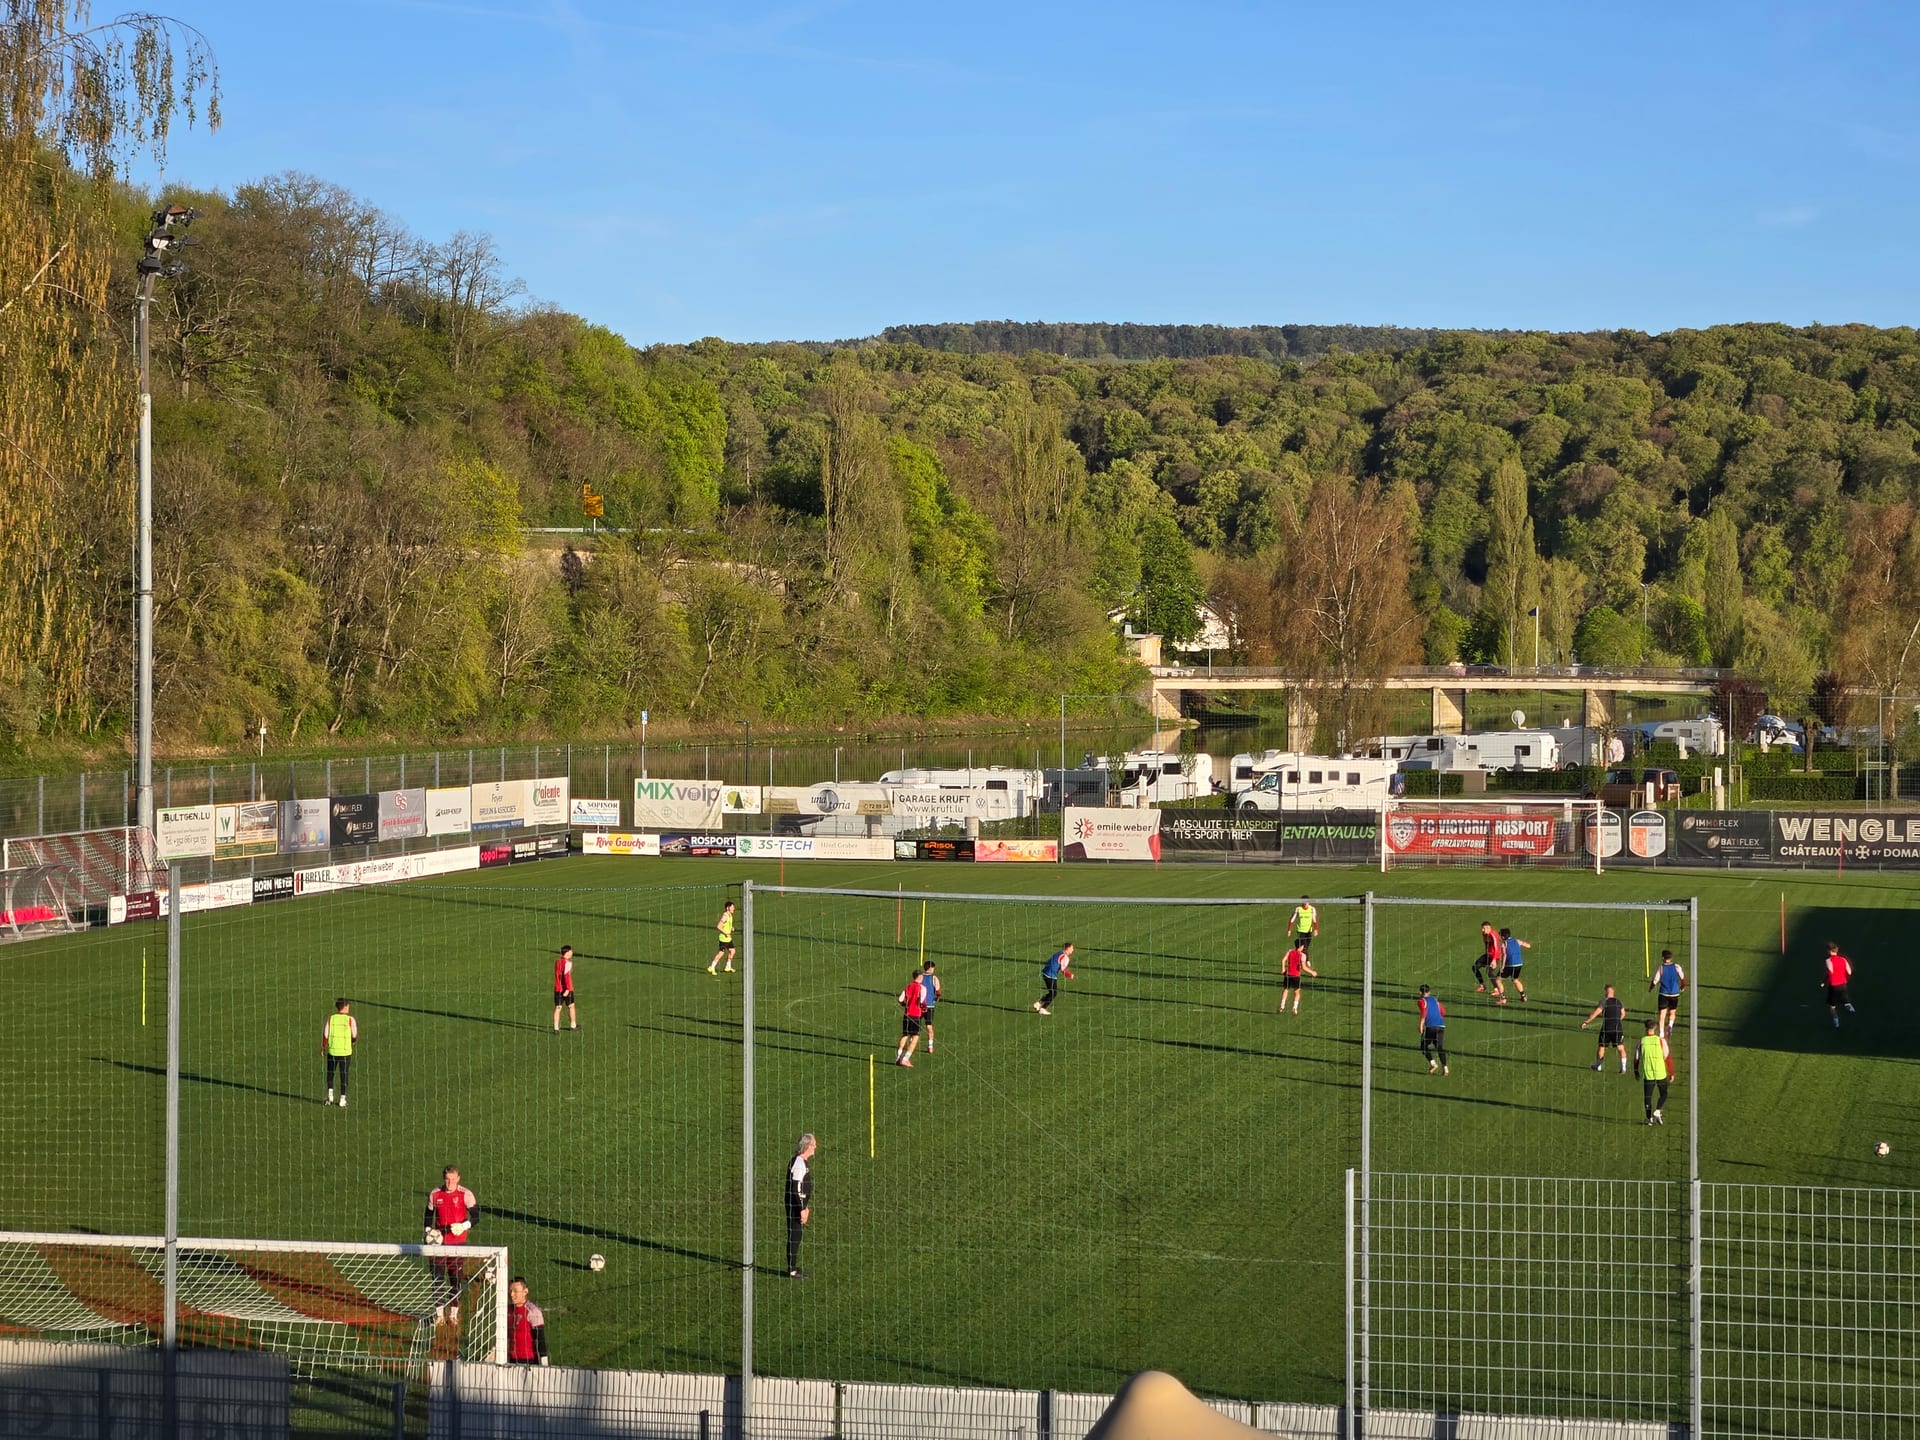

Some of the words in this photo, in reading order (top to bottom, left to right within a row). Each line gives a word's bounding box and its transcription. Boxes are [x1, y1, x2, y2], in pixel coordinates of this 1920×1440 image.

[899, 794, 937, 804] GARAGE
[940, 795, 970, 804] KRUFT
[588, 802, 618, 810] SOPINOR
[906, 806, 964, 814] www.kruft.lu
[162, 812, 210, 823] BULTGEN.LU
[1097, 822, 1121, 831] emile
[1124, 823, 1152, 832] weber
[1173, 820, 1222, 829] ABSOLUTE
[1224, 820, 1279, 830] TEAMSPORT
[1420, 819, 1434, 834] FC
[1438, 819, 1490, 835] VICTORIA
[1495, 820, 1548, 836] ROSPORT
[1696, 819, 1739, 828] IMMOFLEX
[1174, 830, 1224, 839] TTS-SPORT
[1227, 831, 1253, 840] TRIER
[596, 836, 614, 848] Rive
[615, 837, 646, 849] Gauche
[690, 836, 736, 846] ROSPORT
[758, 840, 812, 850] 3S-TECH
[1721, 838, 1760, 846] BATIFLEX
[1780, 843, 1842, 856] CHÂTEAUX
[1884, 849, 1920, 858] DOMA
[254, 880, 272, 892] BORN
